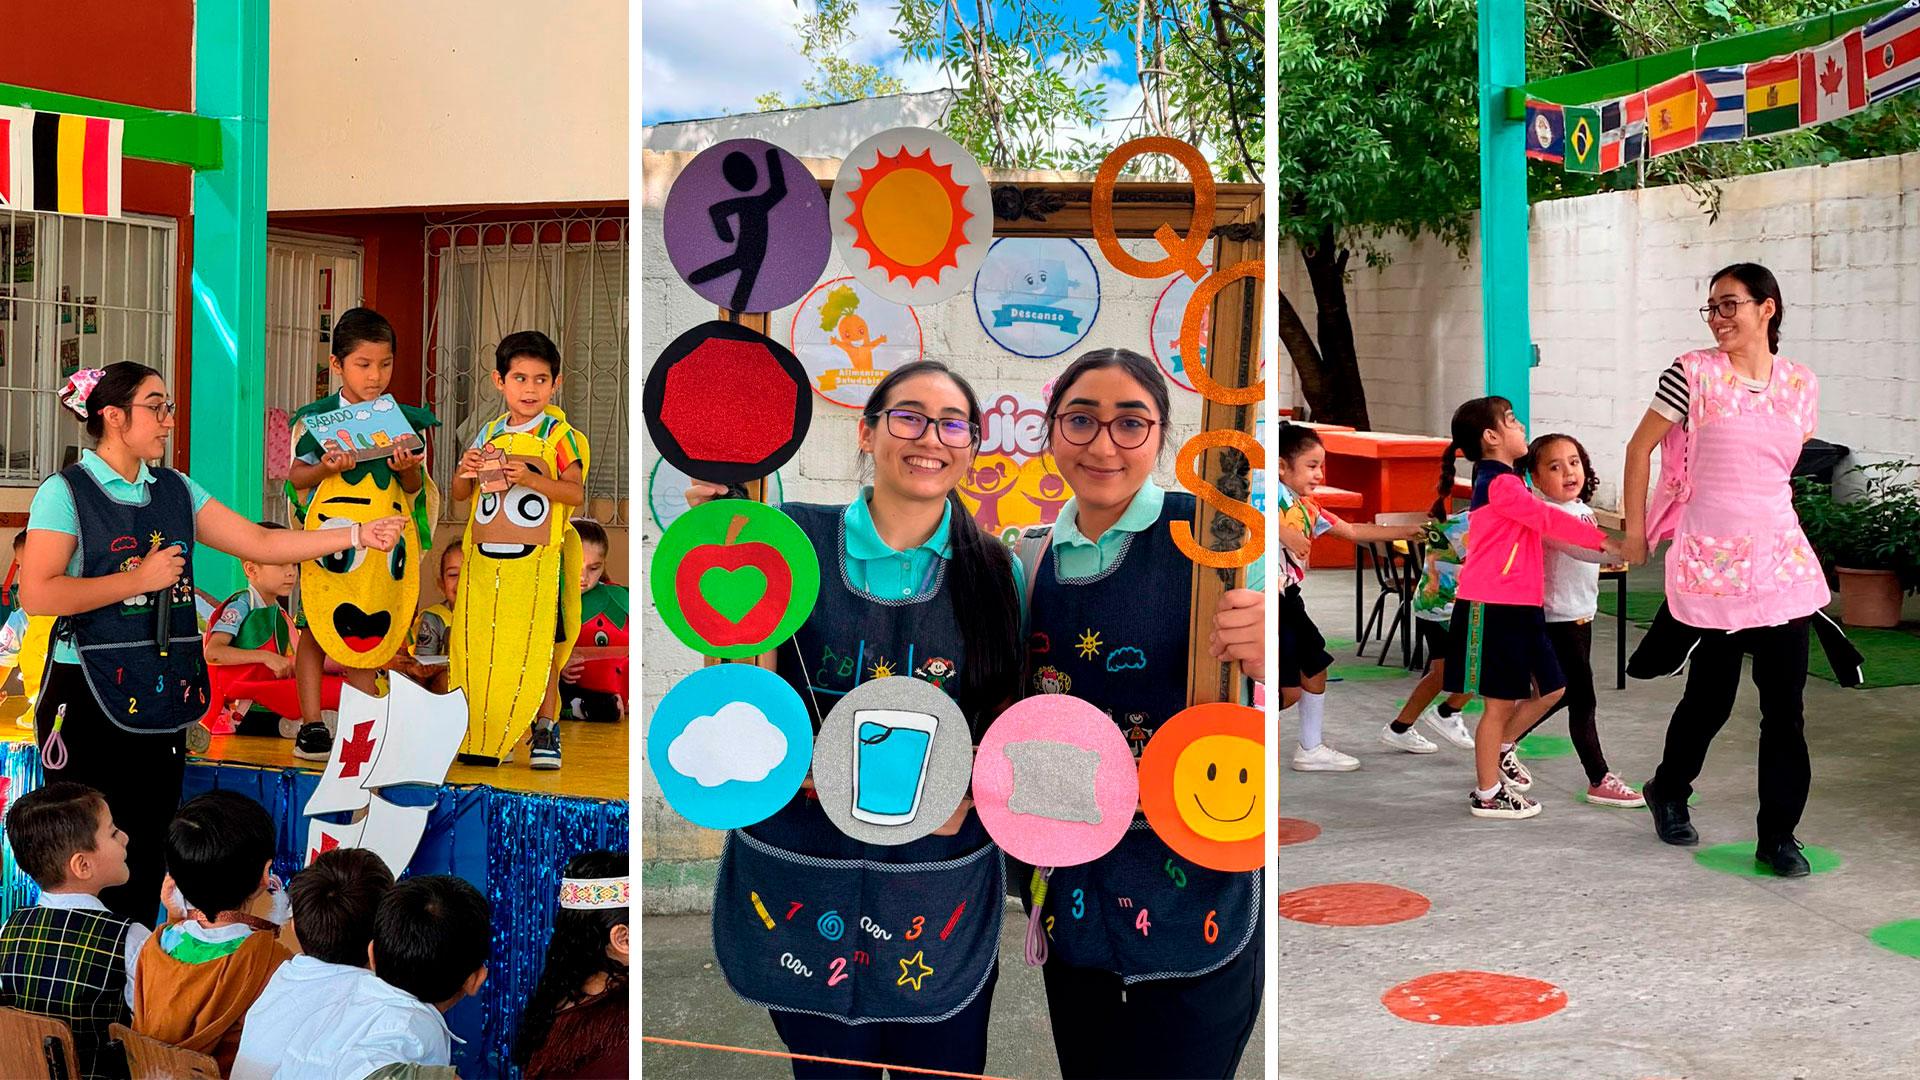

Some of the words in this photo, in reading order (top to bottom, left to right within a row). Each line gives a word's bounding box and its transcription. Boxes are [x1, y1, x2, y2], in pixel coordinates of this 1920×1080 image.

[1010, 308, 1065, 321] Descanso
[835, 377, 881, 385] Saludable
[838, 368, 884, 377] Alimentos
[306, 409, 354, 429] SÁBADO
[116, 667, 124, 685] 1
[837, 656, 854, 677] B
[156, 675, 164, 693] 3
[128, 697, 138, 714] 2
[1164, 858, 1187, 887] 5
[1072, 888, 1085, 919] 3
[905, 916, 925, 940] 3
[1135, 909, 1151, 936] 4
[1203, 910, 1218, 944] 6
[827, 957, 848, 987] 2
